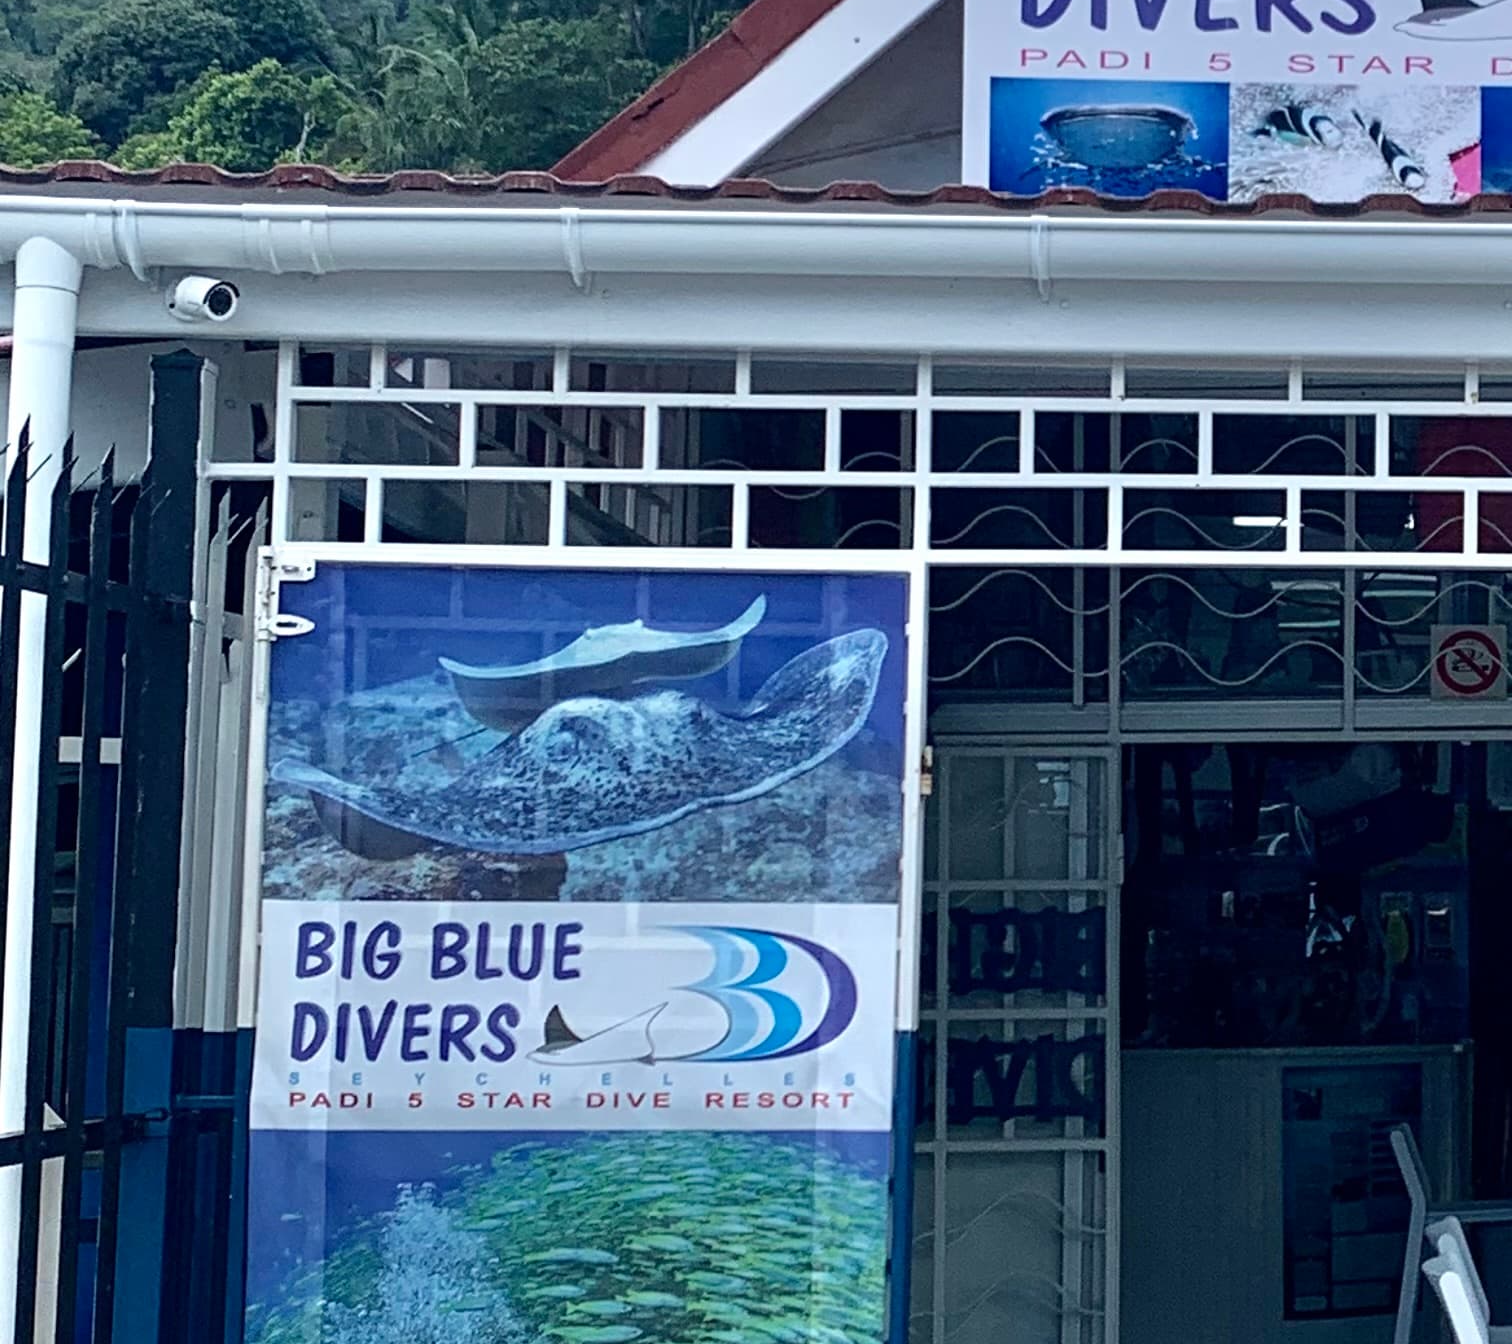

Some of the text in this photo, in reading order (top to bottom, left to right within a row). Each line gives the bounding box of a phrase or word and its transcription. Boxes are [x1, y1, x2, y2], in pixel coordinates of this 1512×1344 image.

[1019, 48, 1153, 71] PADI
[1208, 52, 1233, 71] 5
[1287, 53, 1436, 75] STAR
[294, 920, 584, 982] BIG BLUE
[289, 999, 521, 1064] DIVERS
[288, 1071, 856, 1088] SEYCHELLES
[288, 1091, 855, 1109] PADI 5 STAR DIVE RESORT
